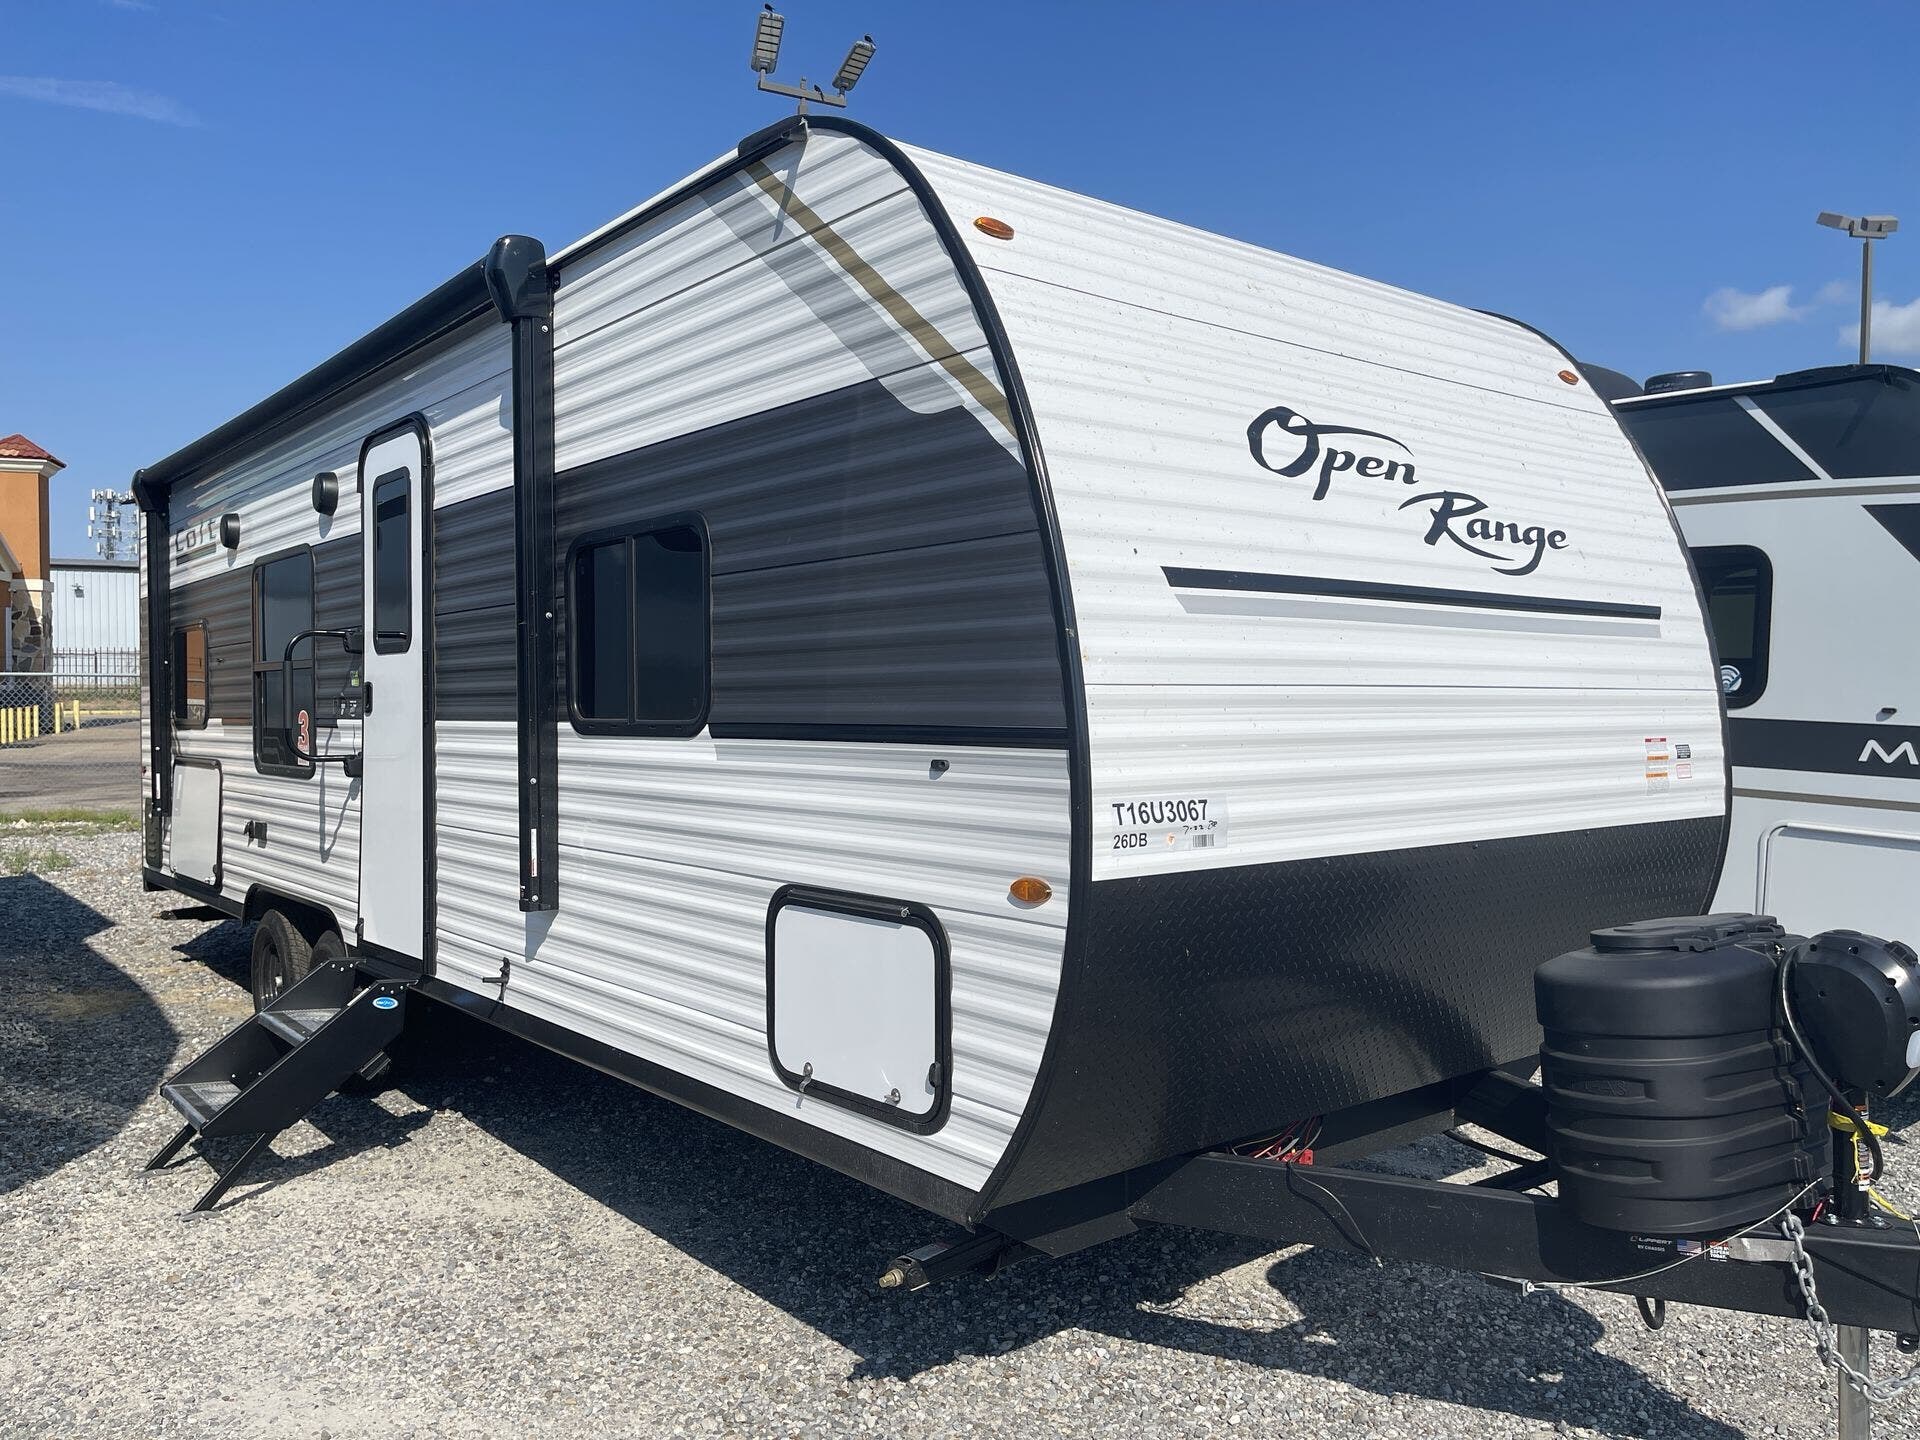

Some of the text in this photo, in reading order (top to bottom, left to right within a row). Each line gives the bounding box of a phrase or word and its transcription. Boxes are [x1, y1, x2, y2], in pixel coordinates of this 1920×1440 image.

[1247, 406, 1419, 500] Open
[1398, 490, 1569, 576] Range
[1112, 799, 1208, 826] T16U3067
[1113, 832, 1148, 850] 26DB
